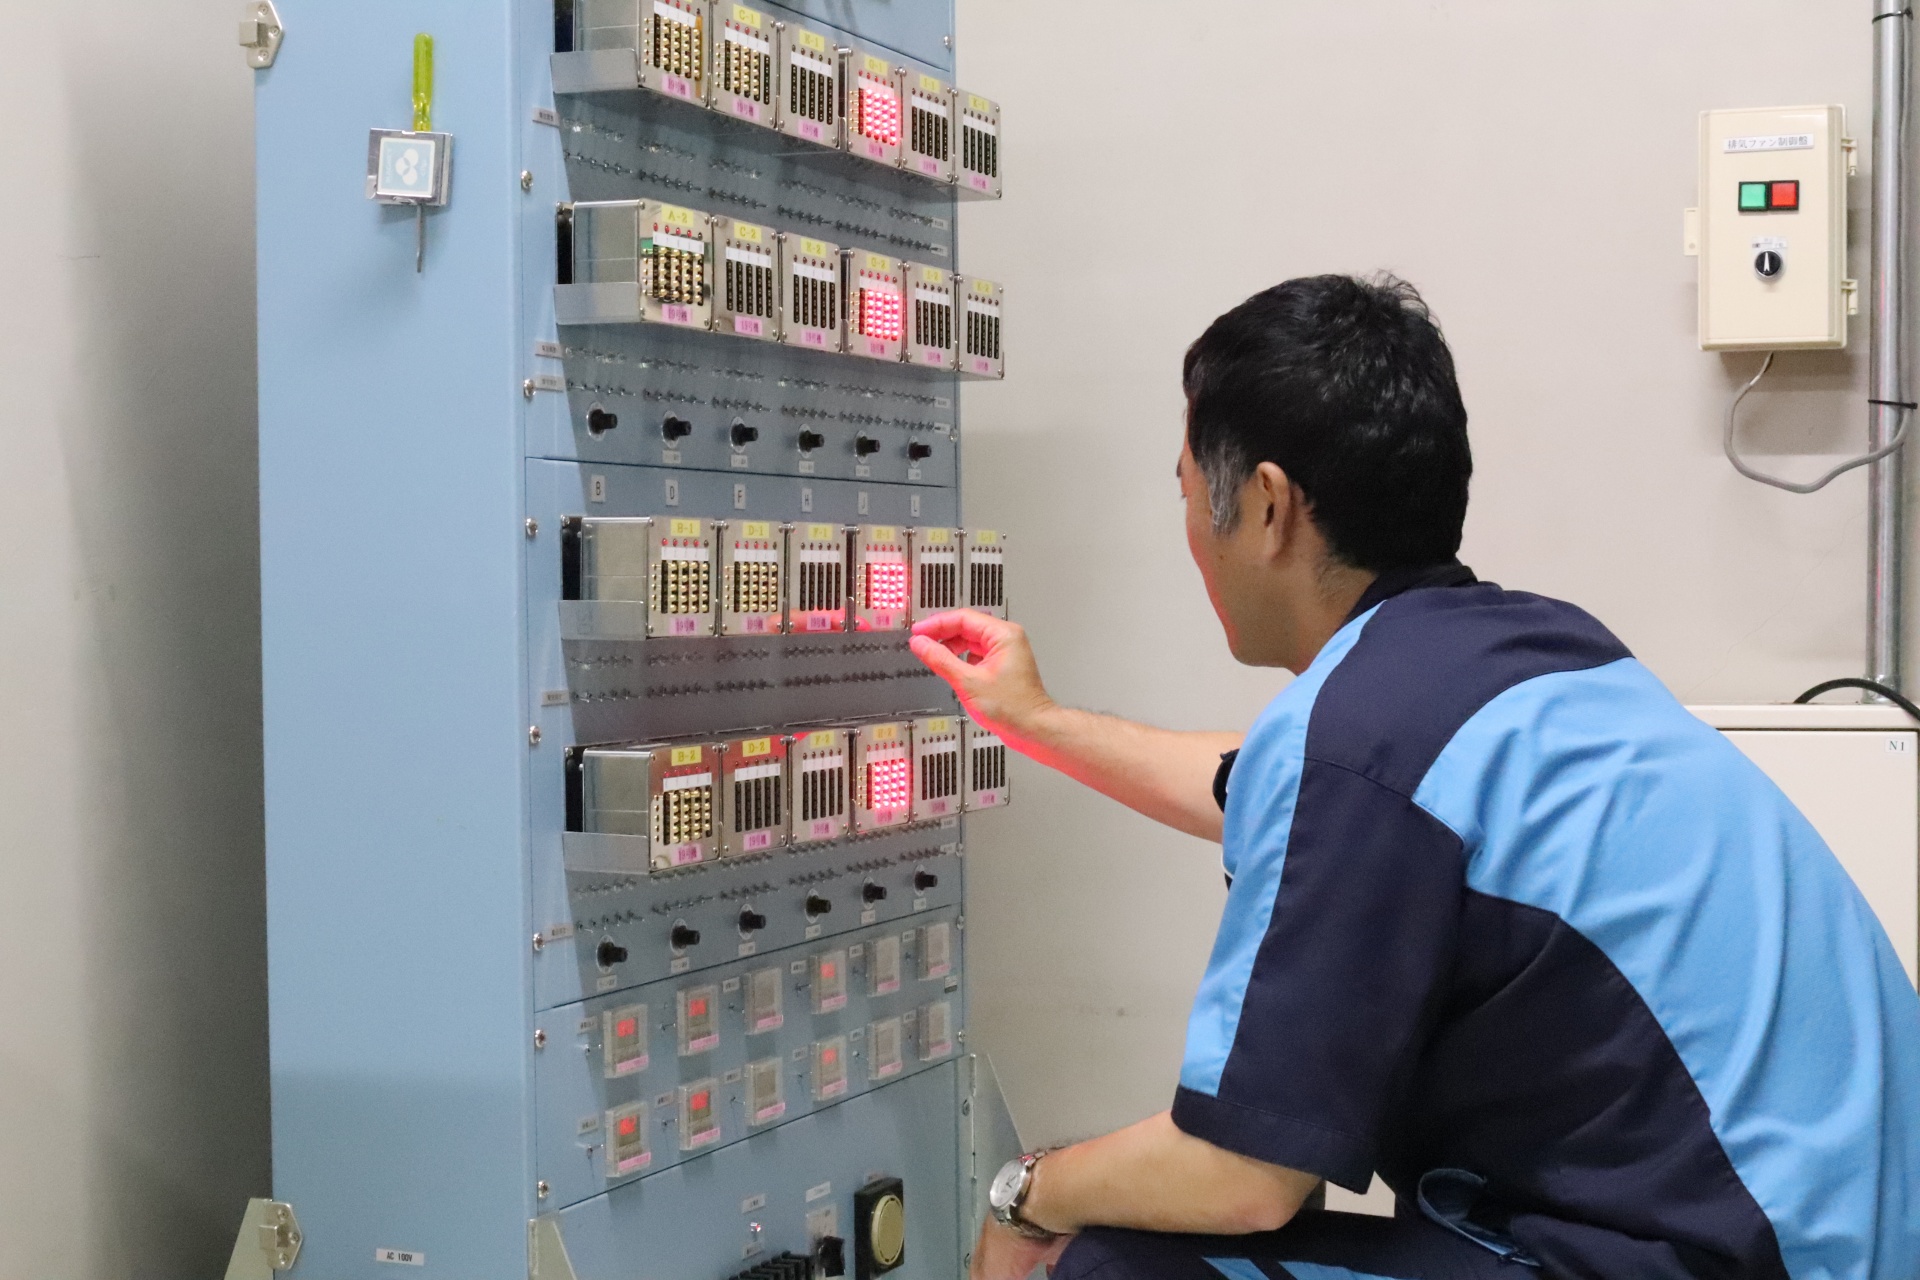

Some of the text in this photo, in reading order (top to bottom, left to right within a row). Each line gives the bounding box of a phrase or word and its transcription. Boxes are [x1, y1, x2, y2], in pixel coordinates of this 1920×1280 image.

[1727, 136, 1808, 149] 排気ファン制御盤
[668, 210, 688, 224] A-2
[740, 226, 756, 239] C-2
[595, 481, 601, 496] B
[669, 485, 675, 500] D
[737, 490, 742, 503] F
[804, 494, 810, 507] H
[677, 522, 694, 534] B-1
[748, 524, 764, 536] D-1
[748, 741, 765, 754] D-2
[677, 750, 696, 762] B-2
[386, 1251, 413, 1262] AC 100V
